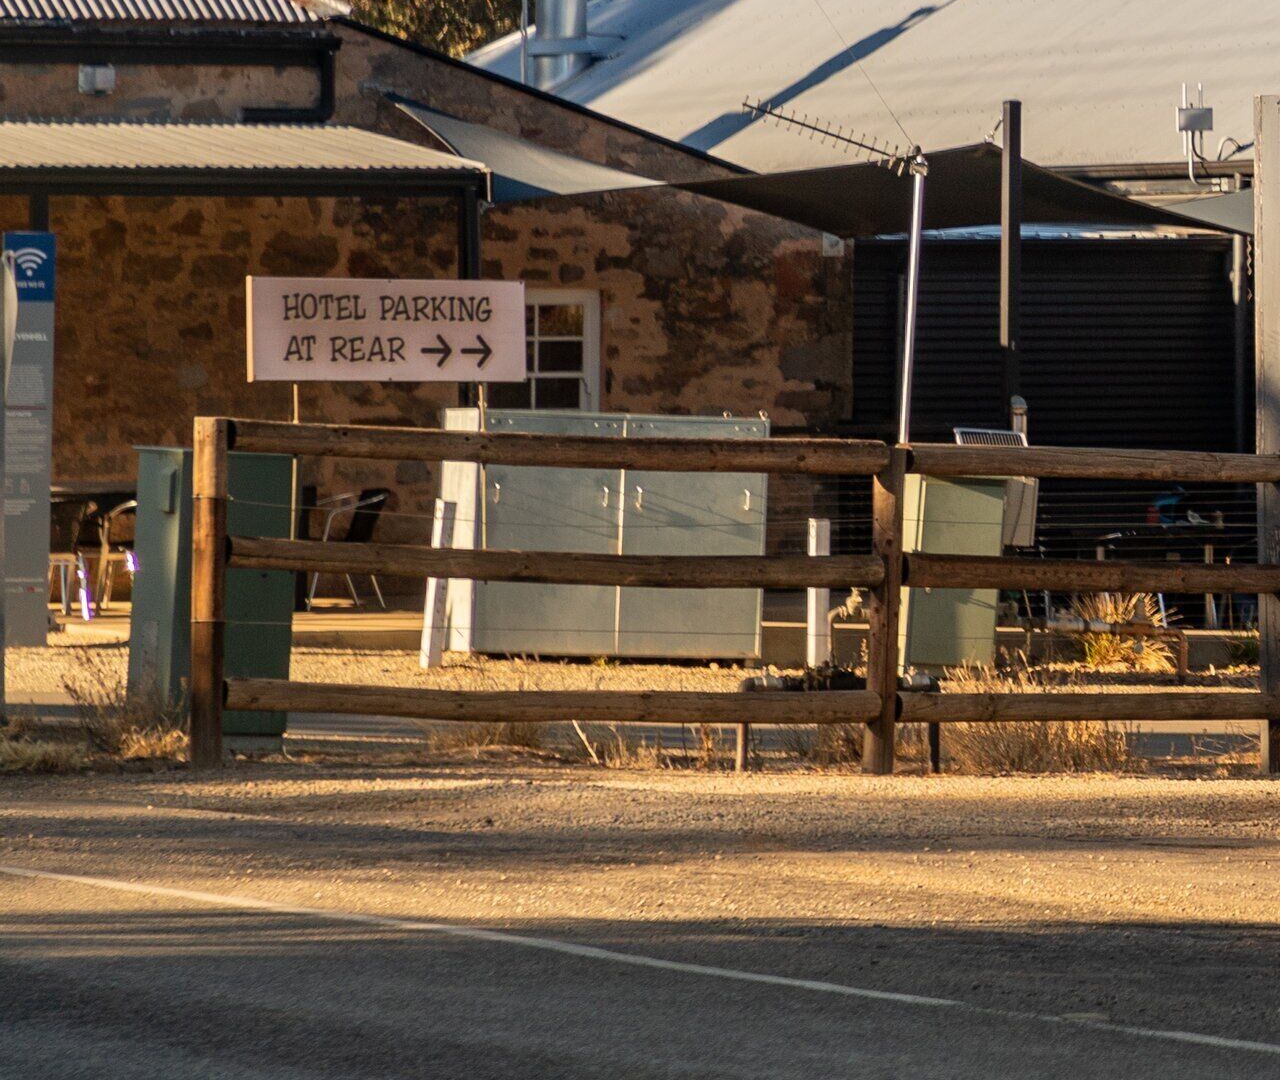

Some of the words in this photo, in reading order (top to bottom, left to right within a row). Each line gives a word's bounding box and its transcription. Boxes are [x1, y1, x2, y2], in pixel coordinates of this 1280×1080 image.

[282, 293, 366, 321] HOTEL
[379, 295, 492, 322] PARKING
[283, 335, 316, 362] AT
[329, 336, 405, 363] REAR
